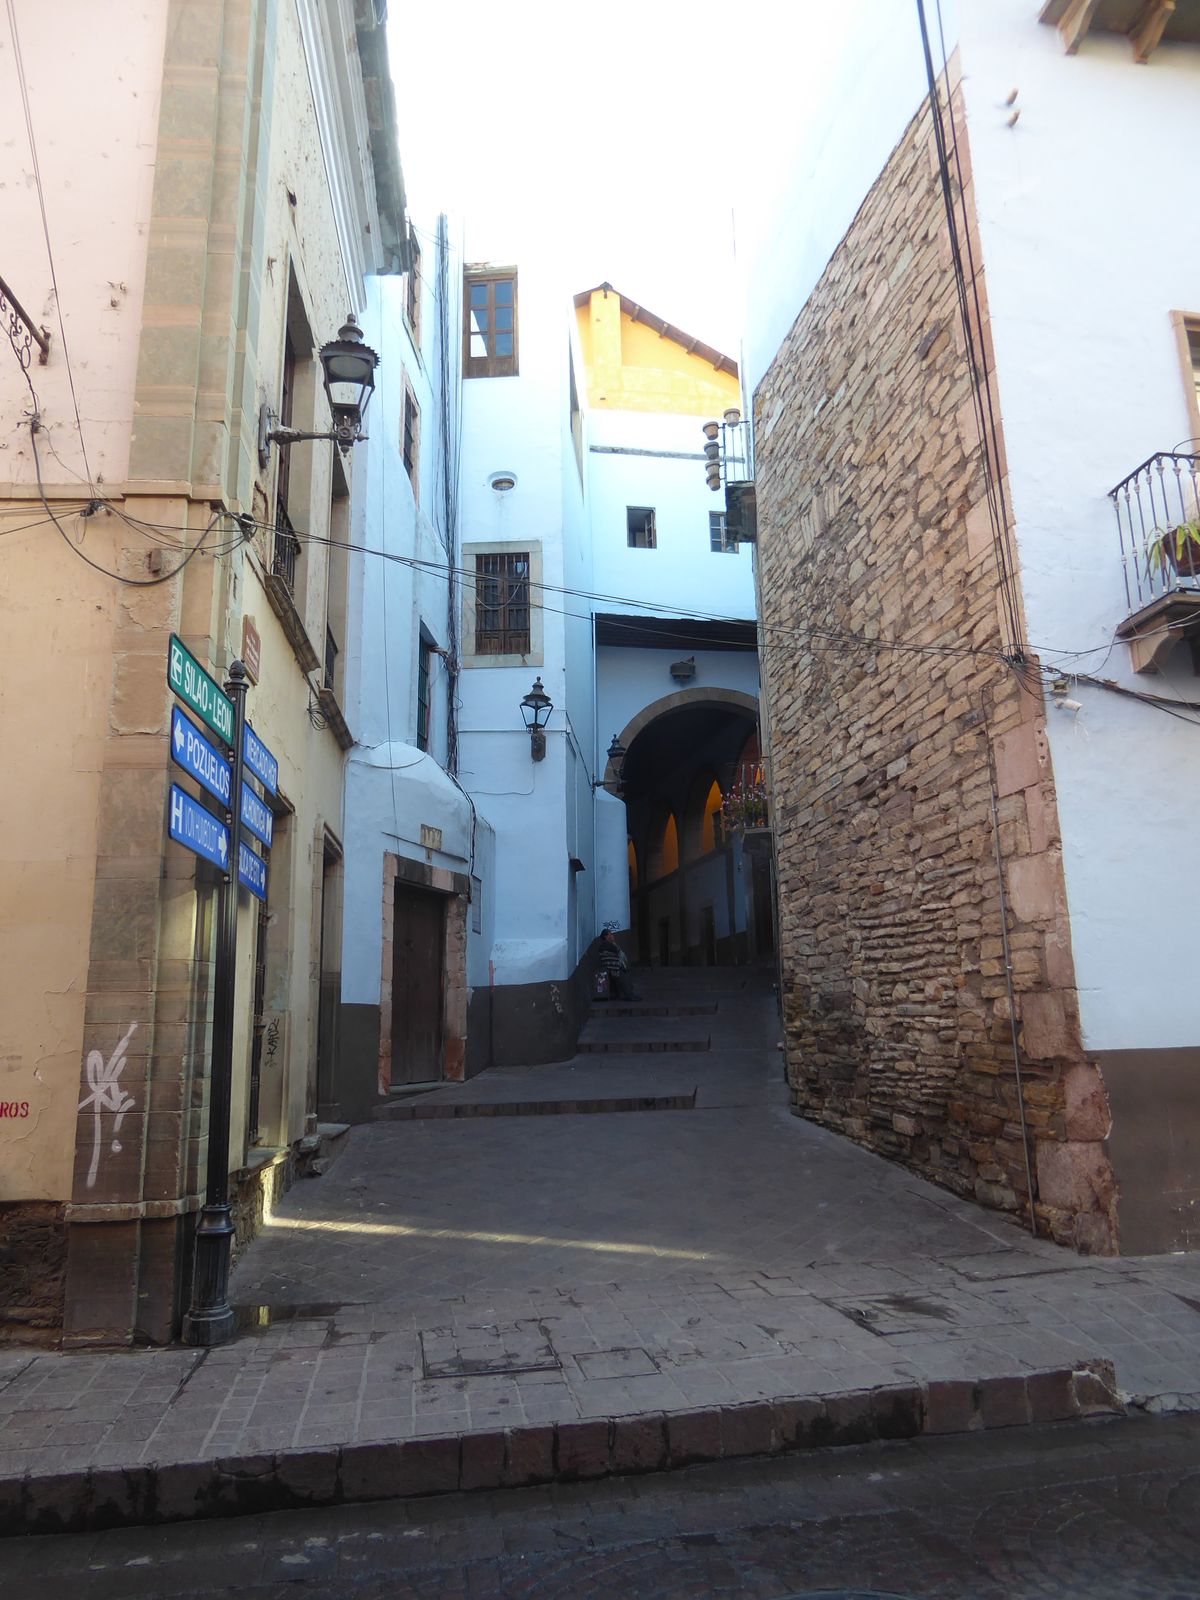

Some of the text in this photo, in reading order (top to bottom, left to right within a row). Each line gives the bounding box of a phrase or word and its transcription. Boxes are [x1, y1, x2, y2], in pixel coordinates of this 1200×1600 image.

[184, 660, 208, 712] SILAO
[212, 692, 232, 737] LEON
[186, 730, 230, 800] POZUELOS
[171, 790, 183, 834] H
